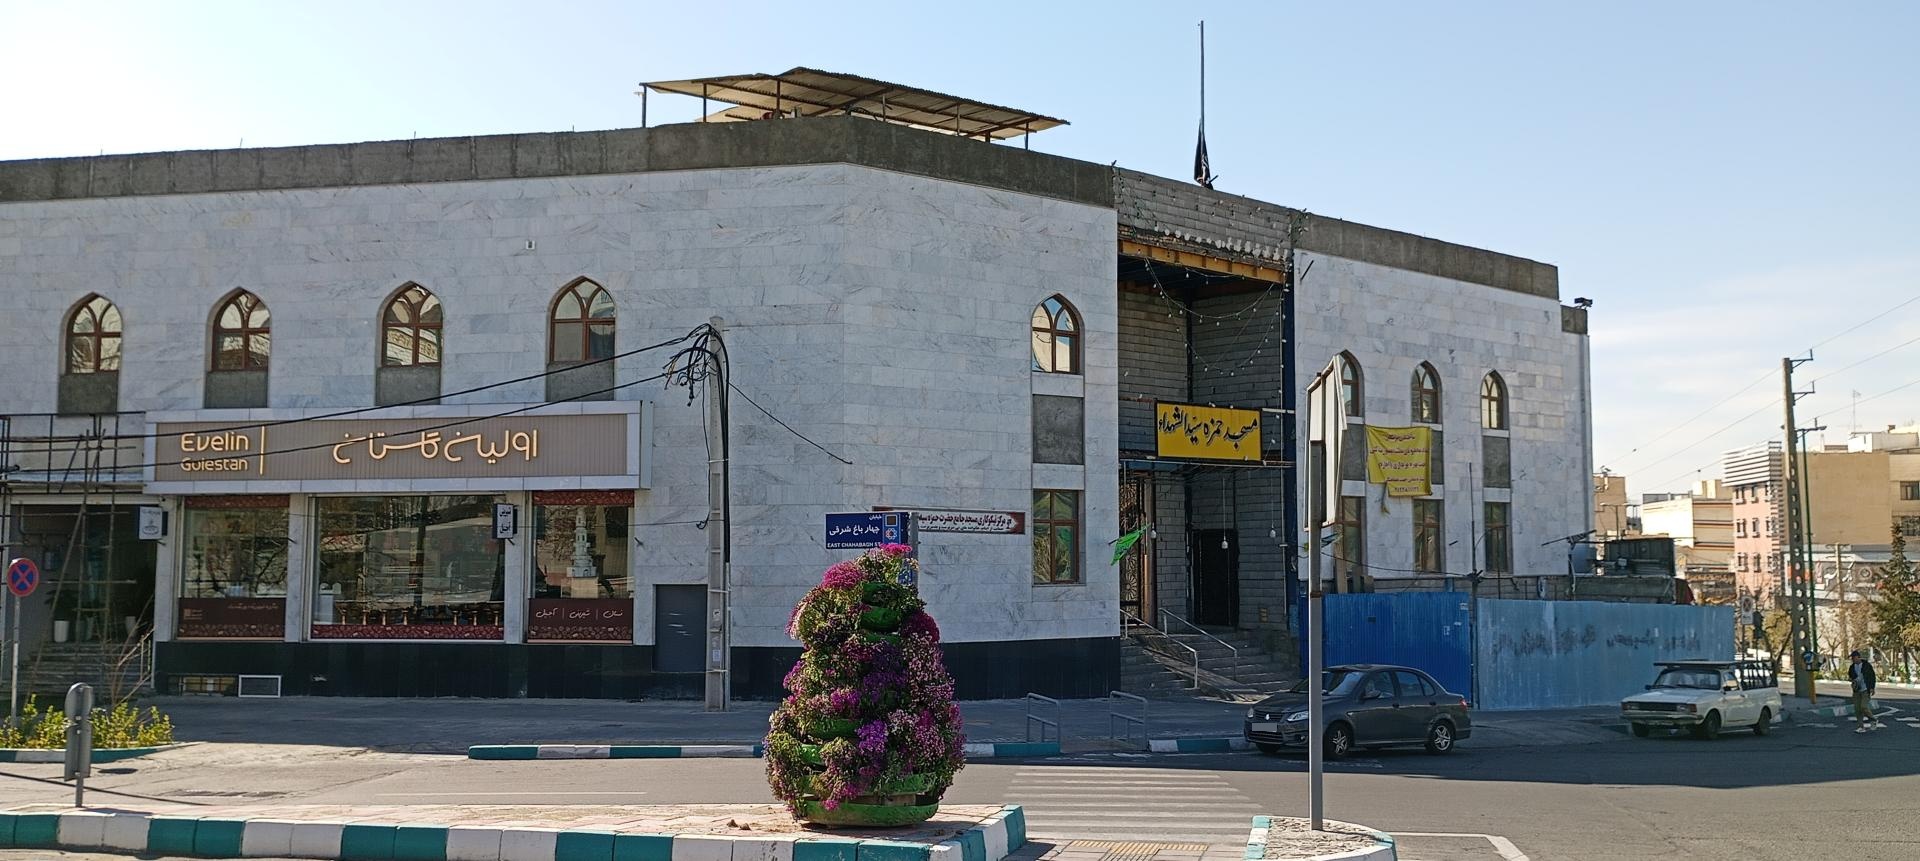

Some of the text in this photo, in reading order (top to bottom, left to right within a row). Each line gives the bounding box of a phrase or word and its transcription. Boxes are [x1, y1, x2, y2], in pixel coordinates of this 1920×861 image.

[1204, 418, 1223, 446] حمزه
[1223, 418, 1258, 450] مسجد
[180, 431, 249, 452] Evelin
[333, 431, 442, 464] گلستان
[928, 513, 939, 525] حمزه
[939, 513, 953, 525] حضرت
[953, 513, 965, 525] جامع
[965, 514, 978, 525] مسجد
[499, 521, 512, 535] آجیل
[829, 523, 880, 536] چهار باغ شرقی
[535, 607, 558, 619] آجیل
